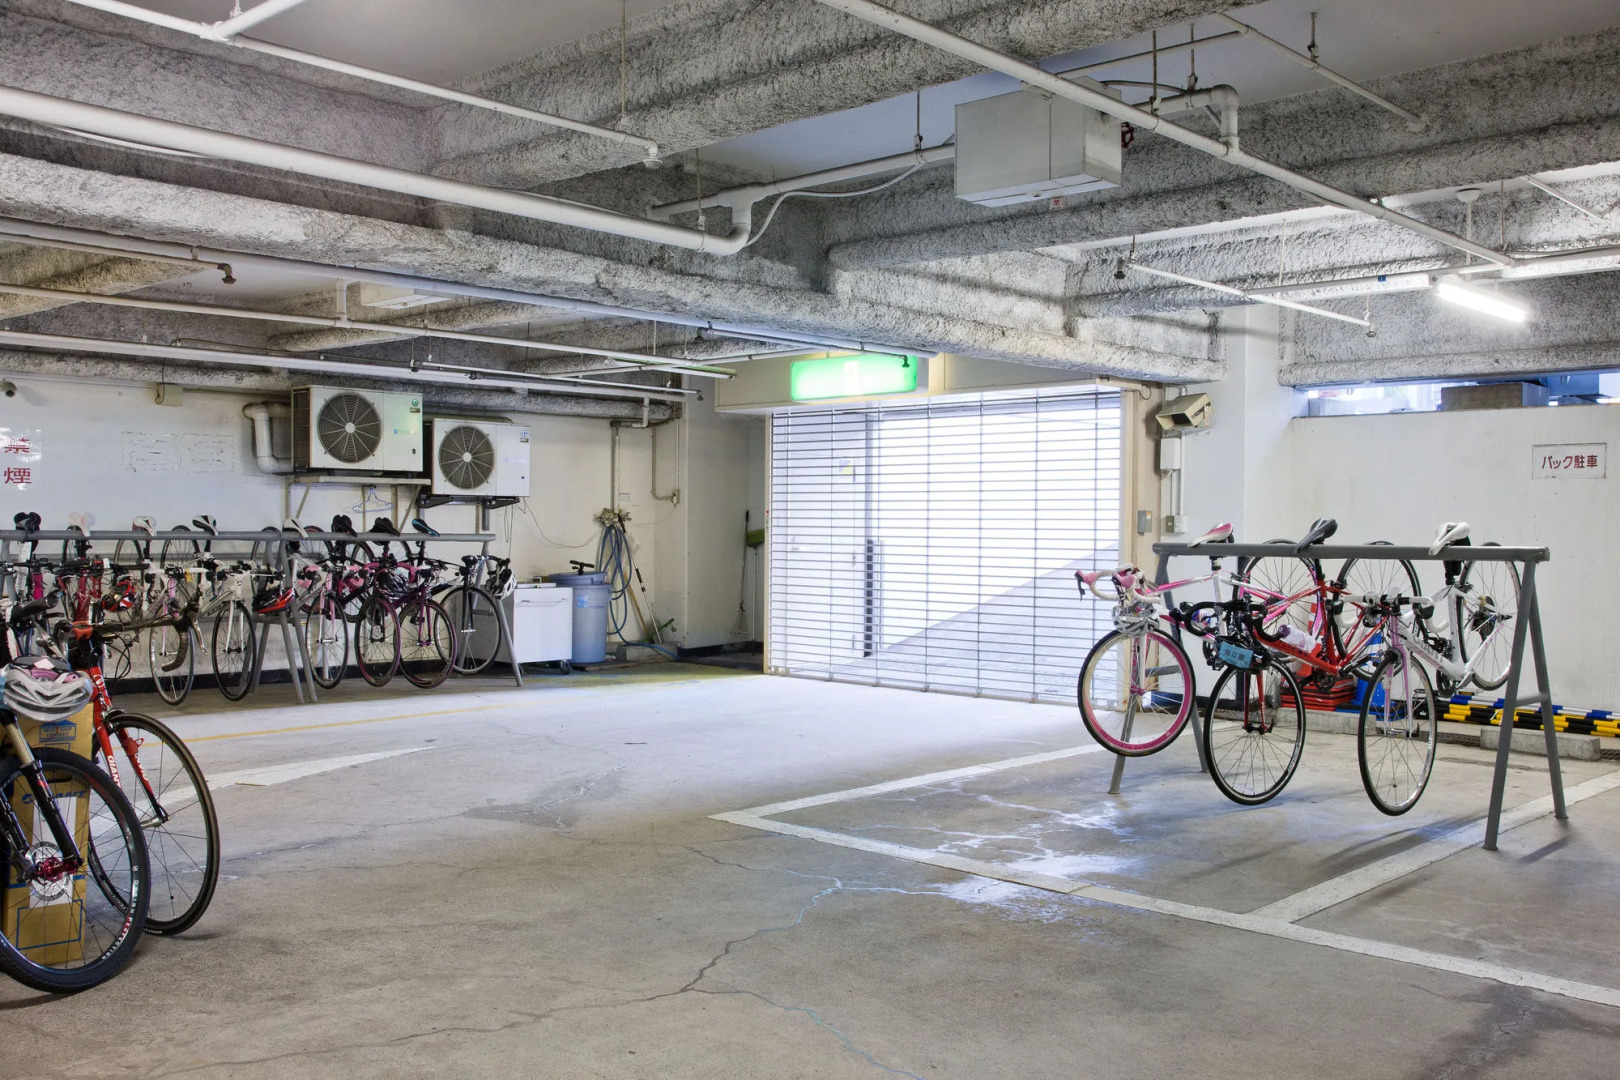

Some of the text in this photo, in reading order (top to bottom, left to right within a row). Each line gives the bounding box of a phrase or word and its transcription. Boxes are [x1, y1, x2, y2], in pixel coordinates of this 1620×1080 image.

[1541, 454, 1598, 469] バック駐車
